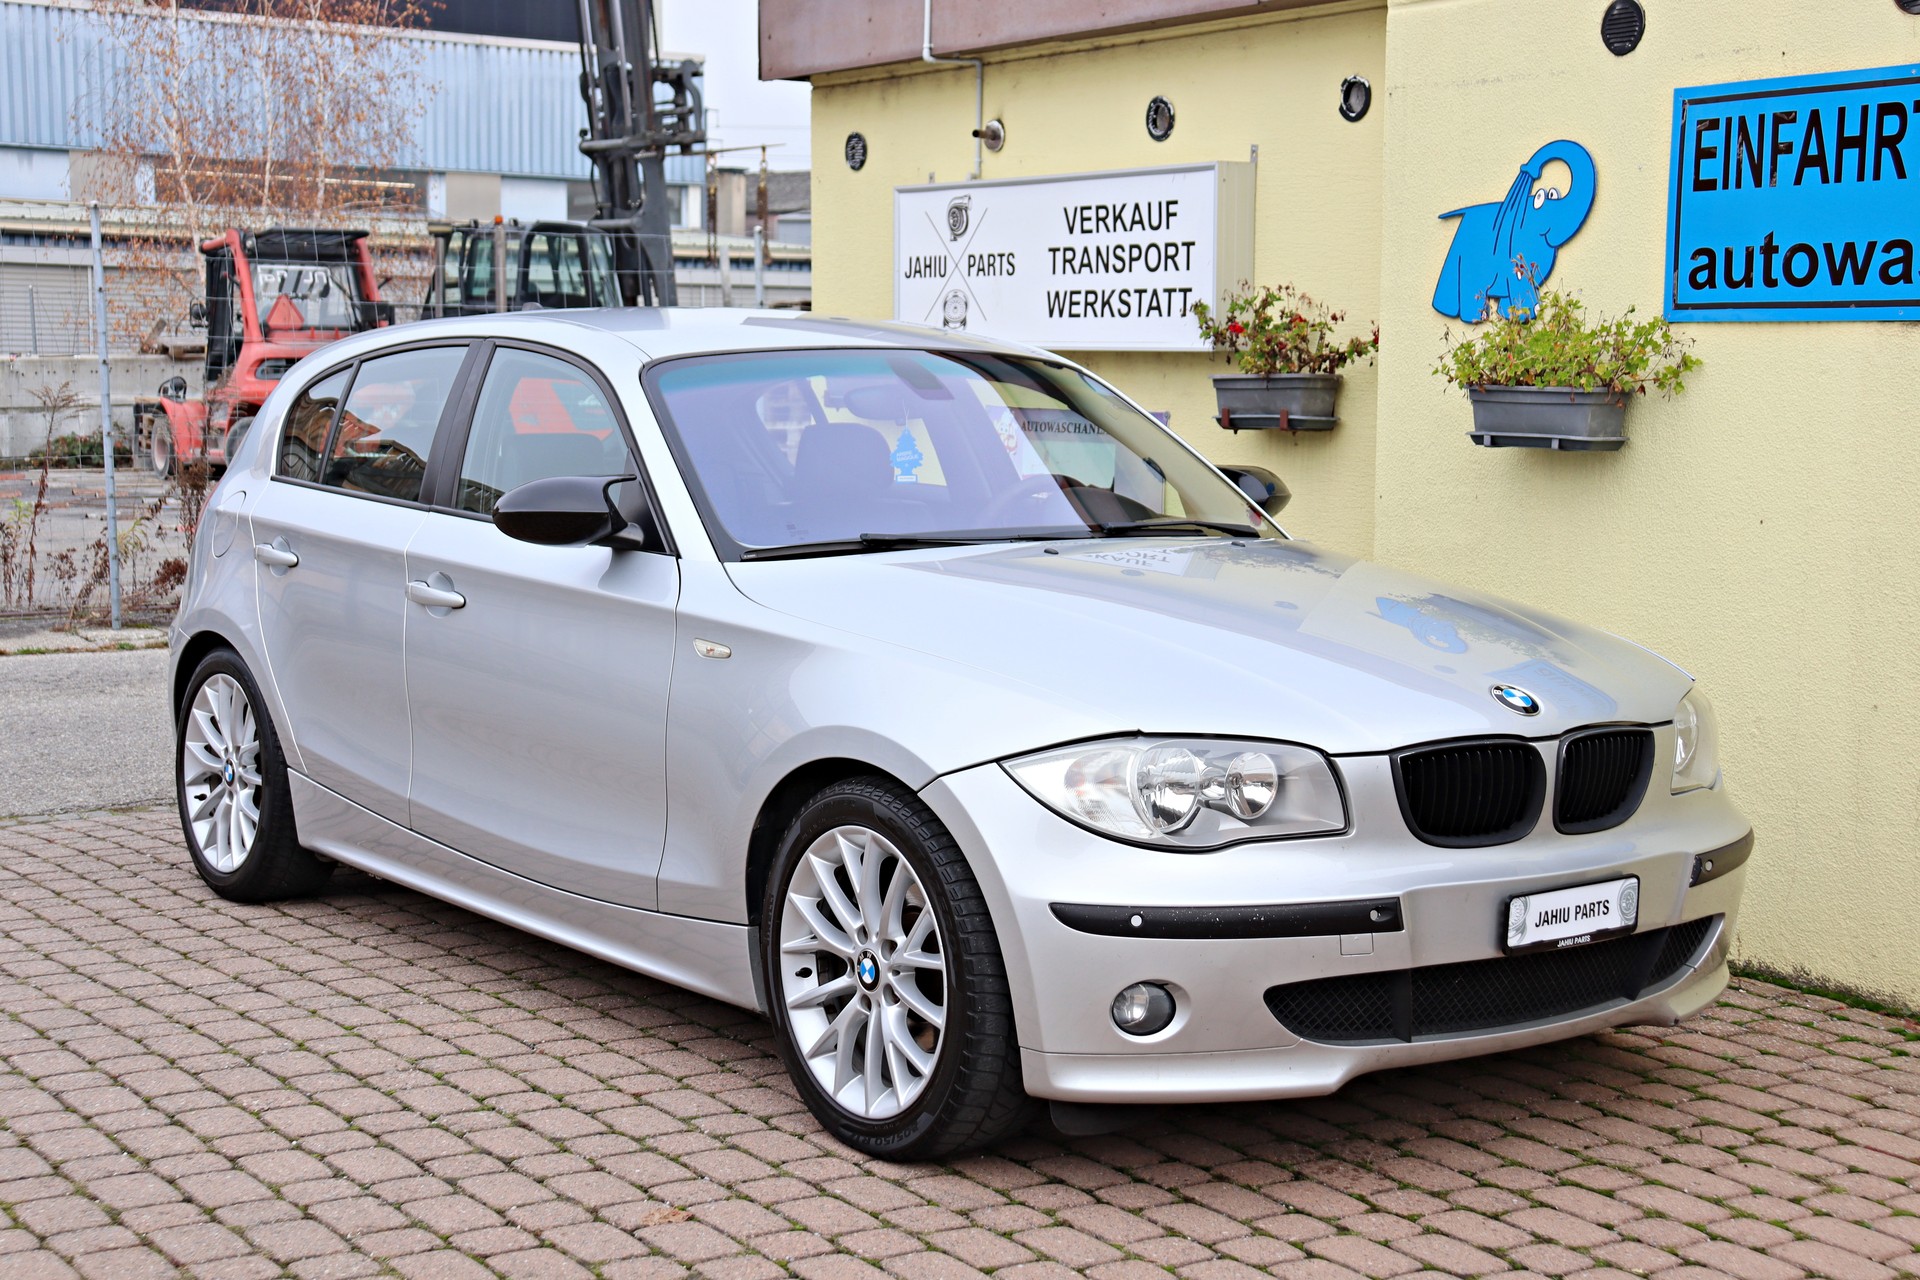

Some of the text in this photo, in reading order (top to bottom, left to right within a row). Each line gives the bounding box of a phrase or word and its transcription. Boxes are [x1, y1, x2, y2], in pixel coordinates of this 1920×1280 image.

[1692, 99, 1920, 193] EINFAHR
[1063, 199, 1179, 235] VERKAUF
[904, 252, 1016, 279] JAHIU PARTS
[1047, 240, 1196, 276] TRANSPORT
[1688, 230, 1920, 291] autowa
[1047, 287, 1193, 319] WERKSTATT
[1534, 899, 1610, 928] JAHIU PARTS
[1557, 935, 1591, 948] JAHIU PARTS
